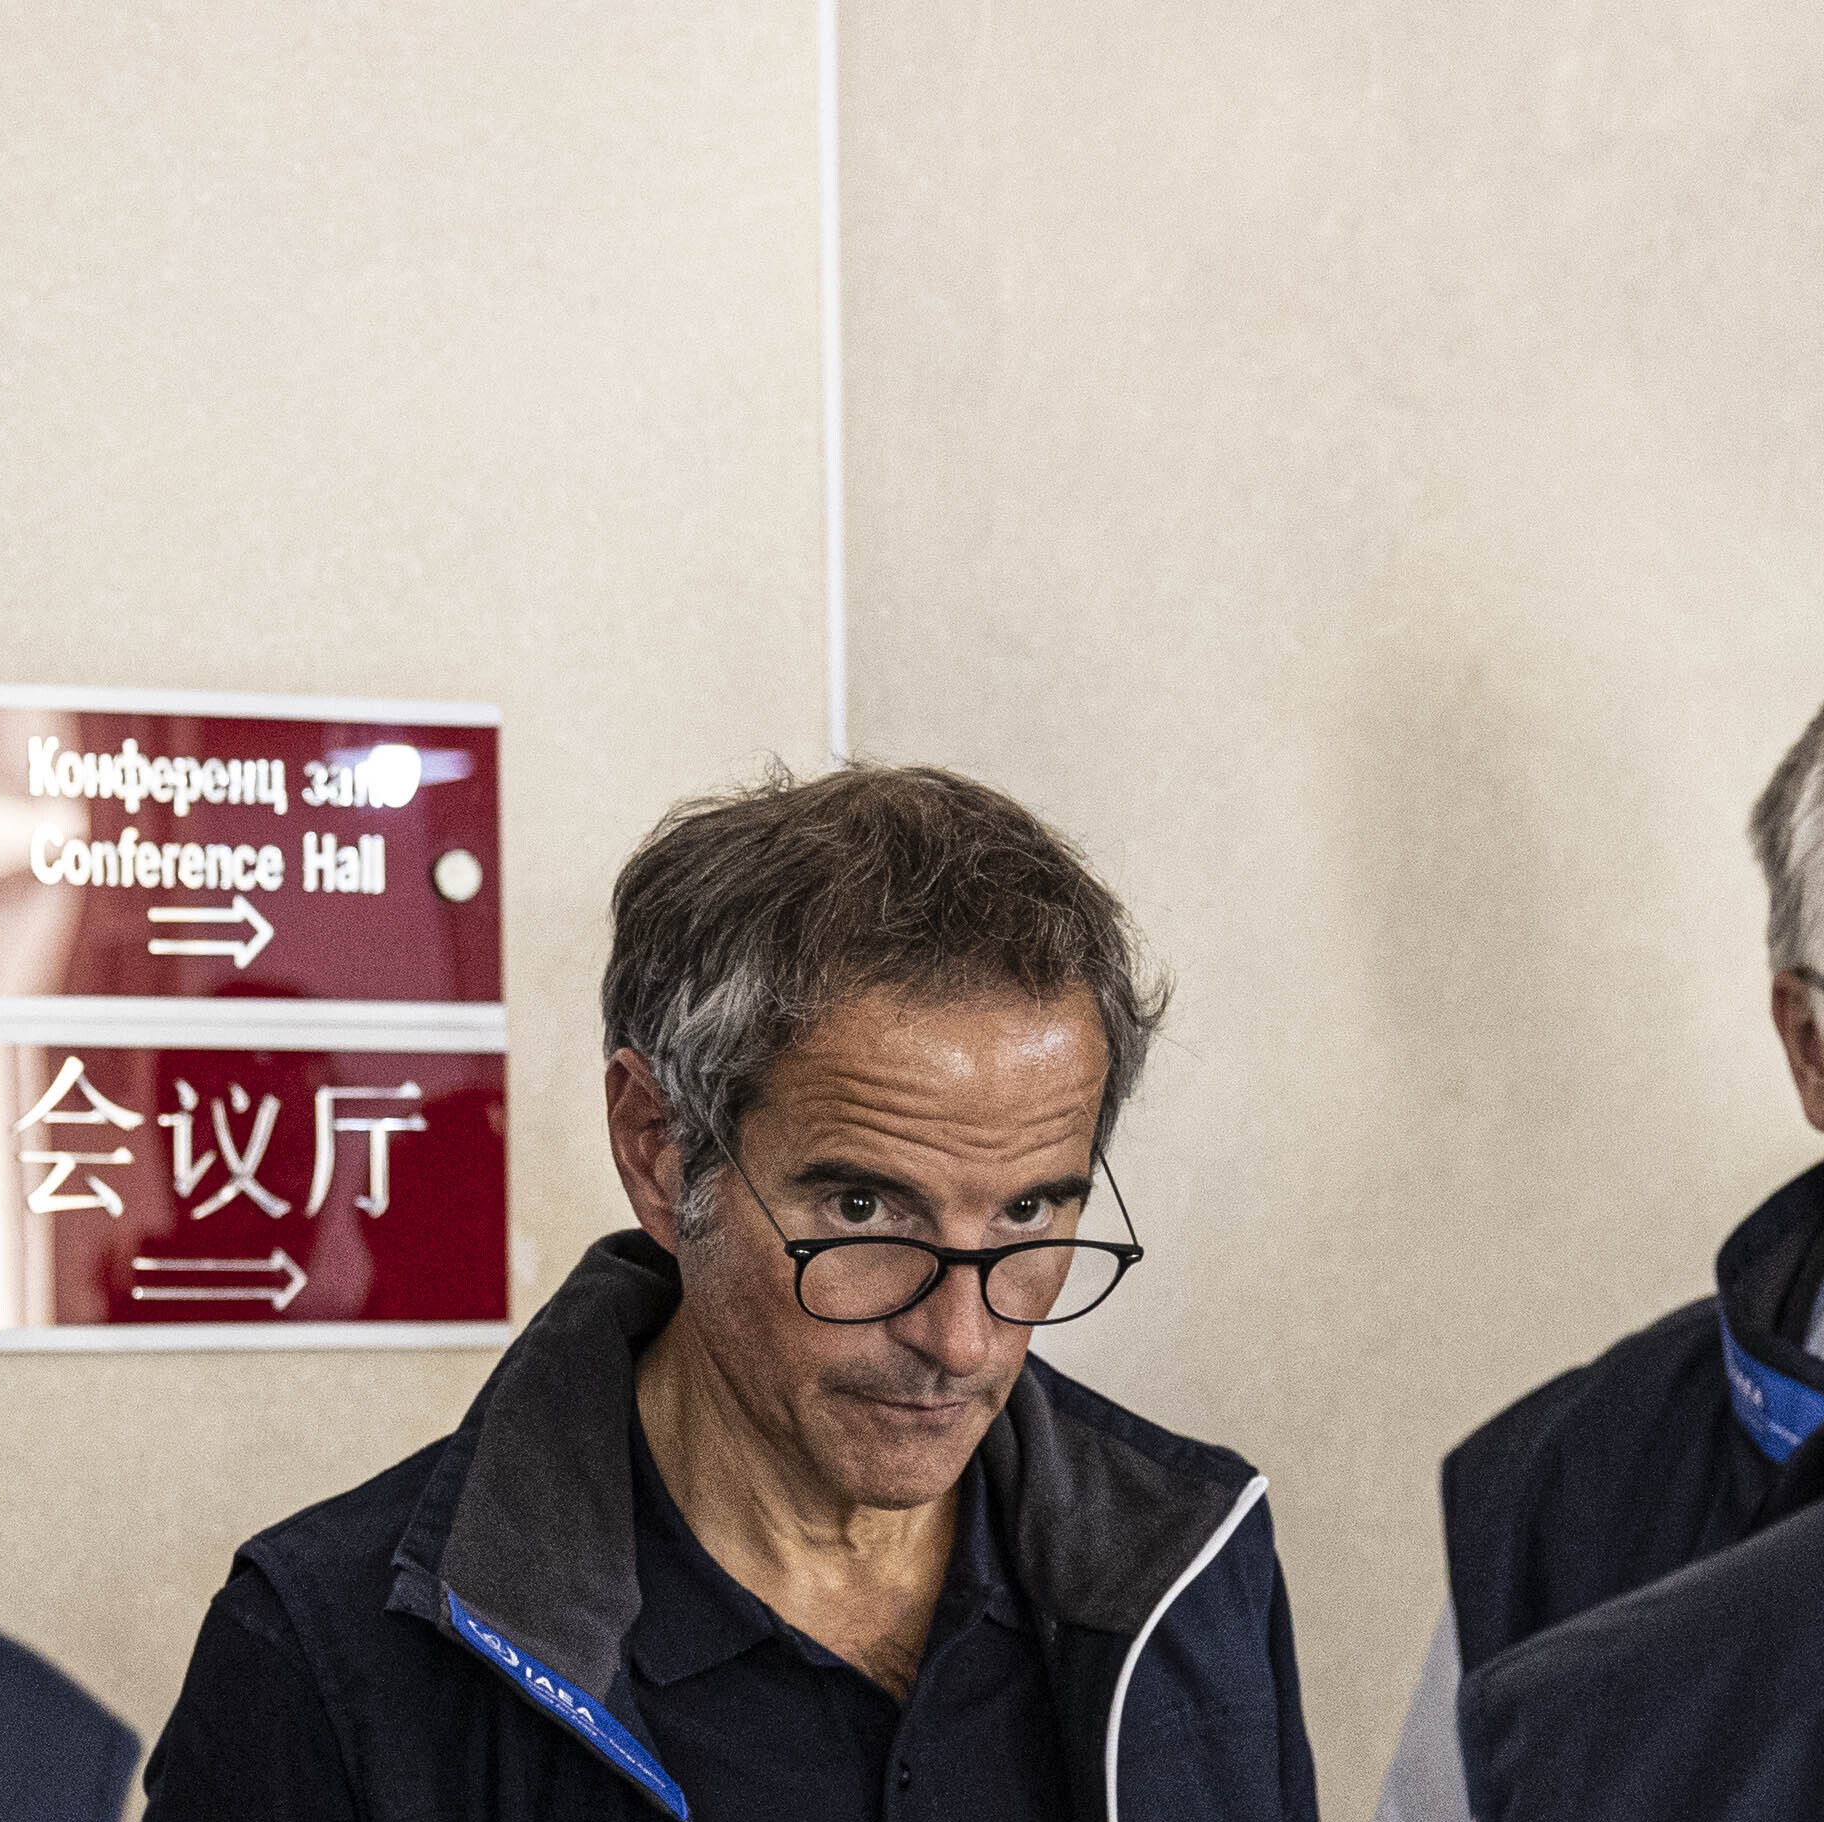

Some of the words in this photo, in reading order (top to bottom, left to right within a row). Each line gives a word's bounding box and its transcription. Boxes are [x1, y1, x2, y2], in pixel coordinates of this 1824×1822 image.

[27, 735, 288, 816] Конференц
[30, 822, 285, 892] Conference
[302, 830, 386, 894] Hall
[12, 1055, 428, 1221] 会议厅
[525, 1666, 595, 1724] IAEA
